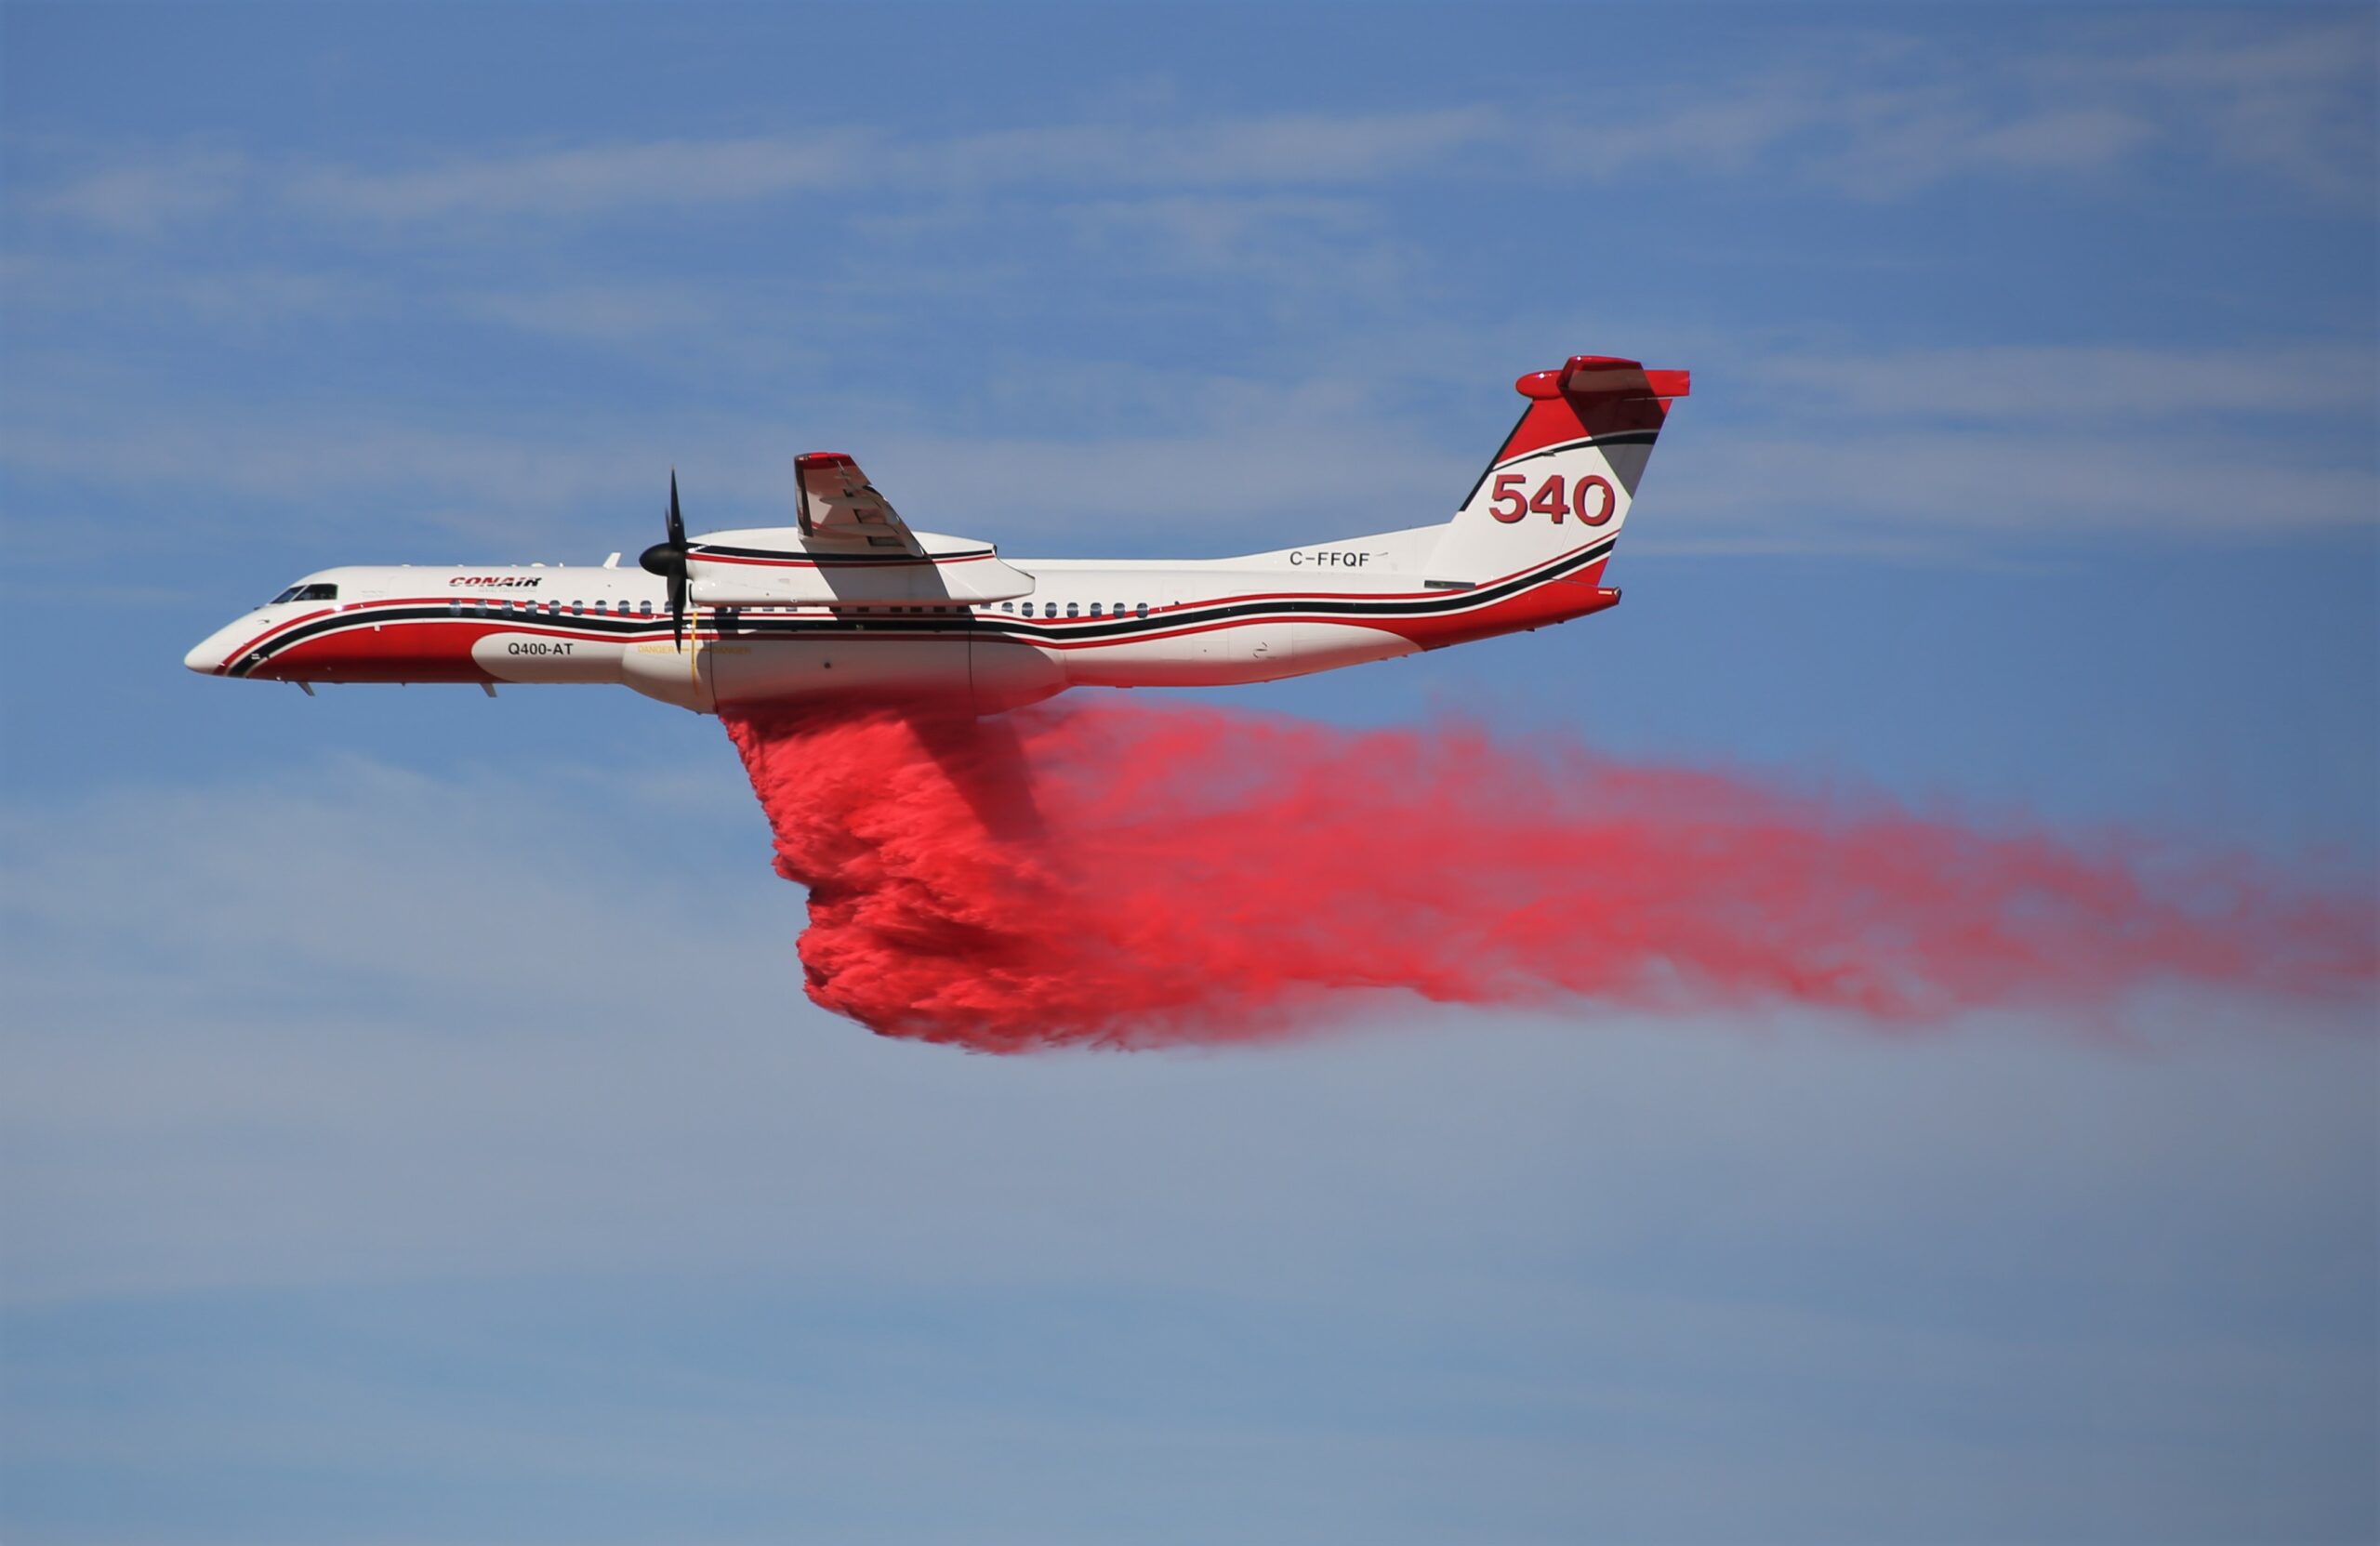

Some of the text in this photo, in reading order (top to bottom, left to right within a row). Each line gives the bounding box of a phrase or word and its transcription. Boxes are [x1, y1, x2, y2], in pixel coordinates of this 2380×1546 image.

[1488, 474, 1616, 527] 540
[1289, 550, 1370, 567] C-FFQF
[508, 642, 574, 655] Q400-AT
